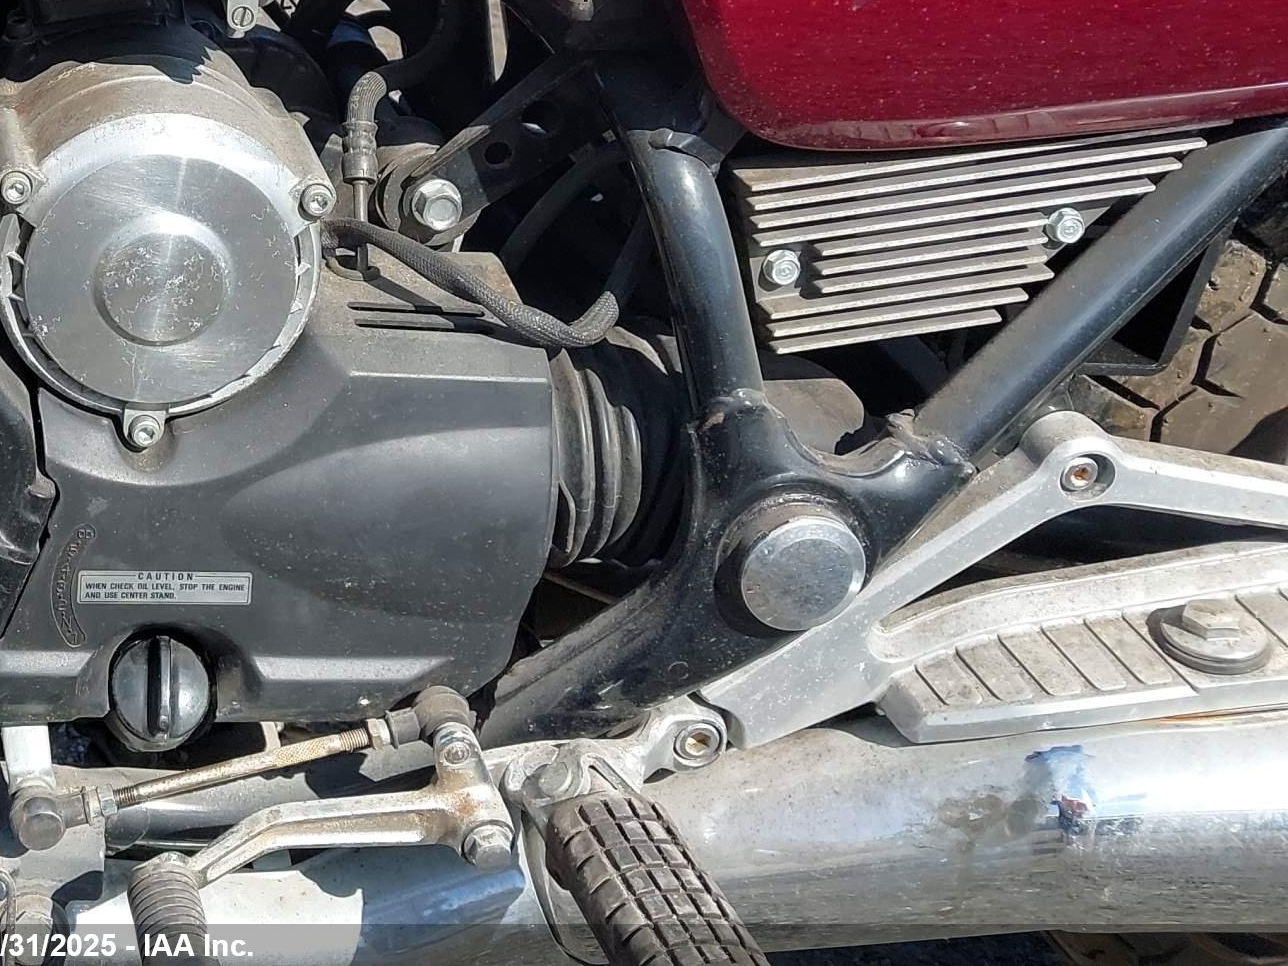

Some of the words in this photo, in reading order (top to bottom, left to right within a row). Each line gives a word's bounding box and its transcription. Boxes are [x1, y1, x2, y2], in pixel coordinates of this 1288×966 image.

[137, 572, 193, 581] CAUTION
[85, 582, 107, 590] WHEN
[110, 582, 134, 590] CHECK
[137, 582, 149, 590] OIL
[179, 583, 198, 591] STOP
[201, 583, 216, 591] THE
[218, 583, 245, 591] ENGINE
[85, 591, 101, 599] AND
[104, 591, 119, 599] USE
[120, 591, 148, 599] CENTER
